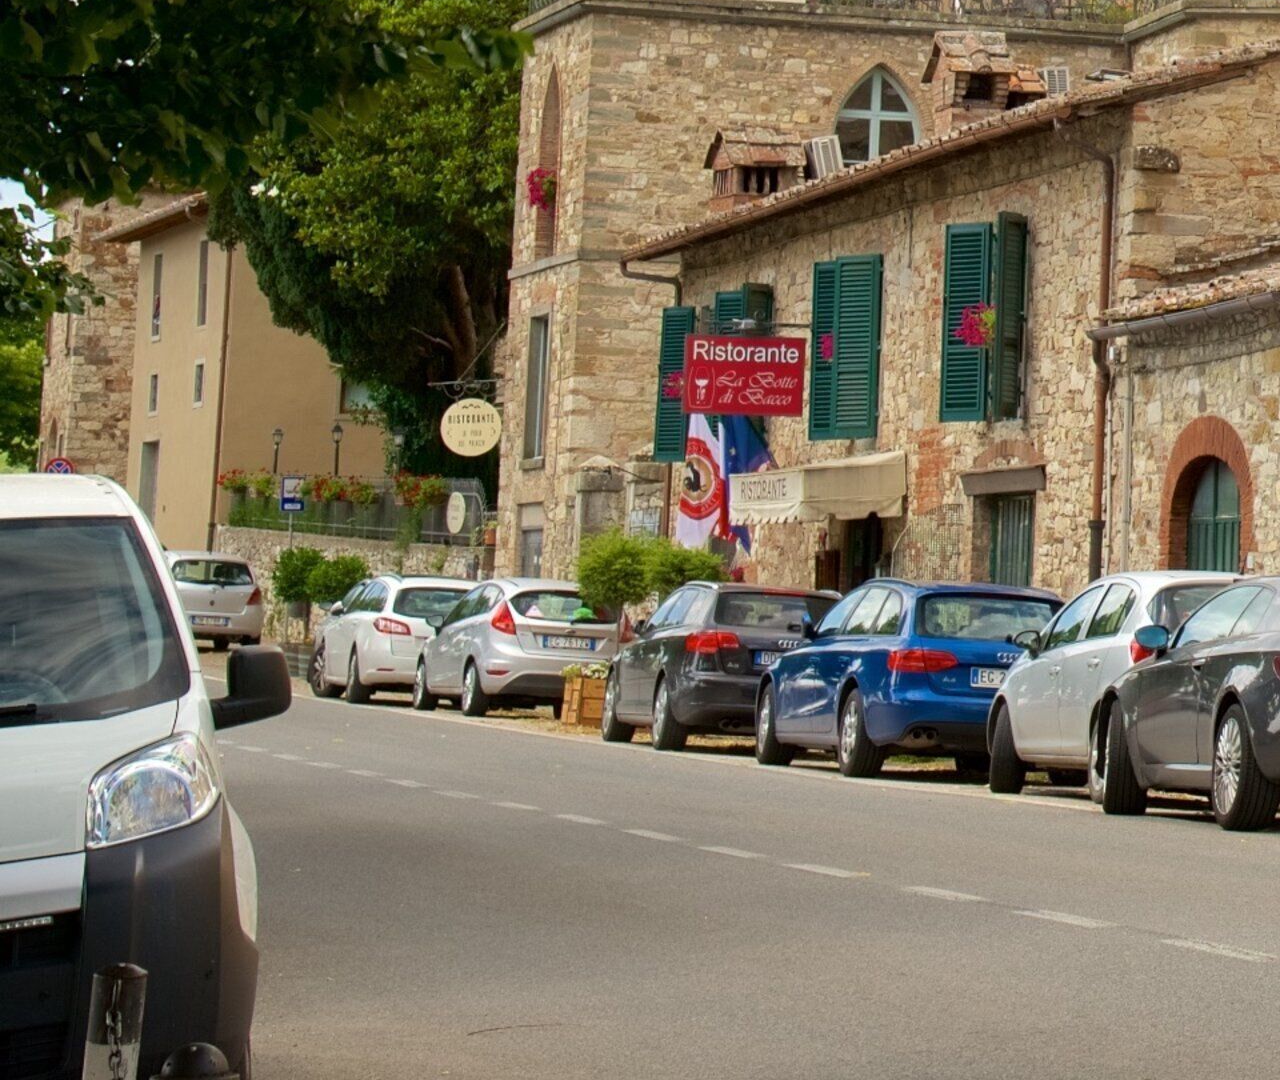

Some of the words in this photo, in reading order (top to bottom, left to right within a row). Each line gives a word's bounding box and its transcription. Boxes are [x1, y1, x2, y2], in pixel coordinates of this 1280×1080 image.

[693, 340, 799, 363] Ristorante
[716, 370, 745, 387] La
[748, 372, 798, 389] Botte
[718, 388, 734, 404] di
[738, 389, 792, 405] Bacco
[741, 478, 786, 500] RISTORANTE
[980, 671, 994, 683] EG
